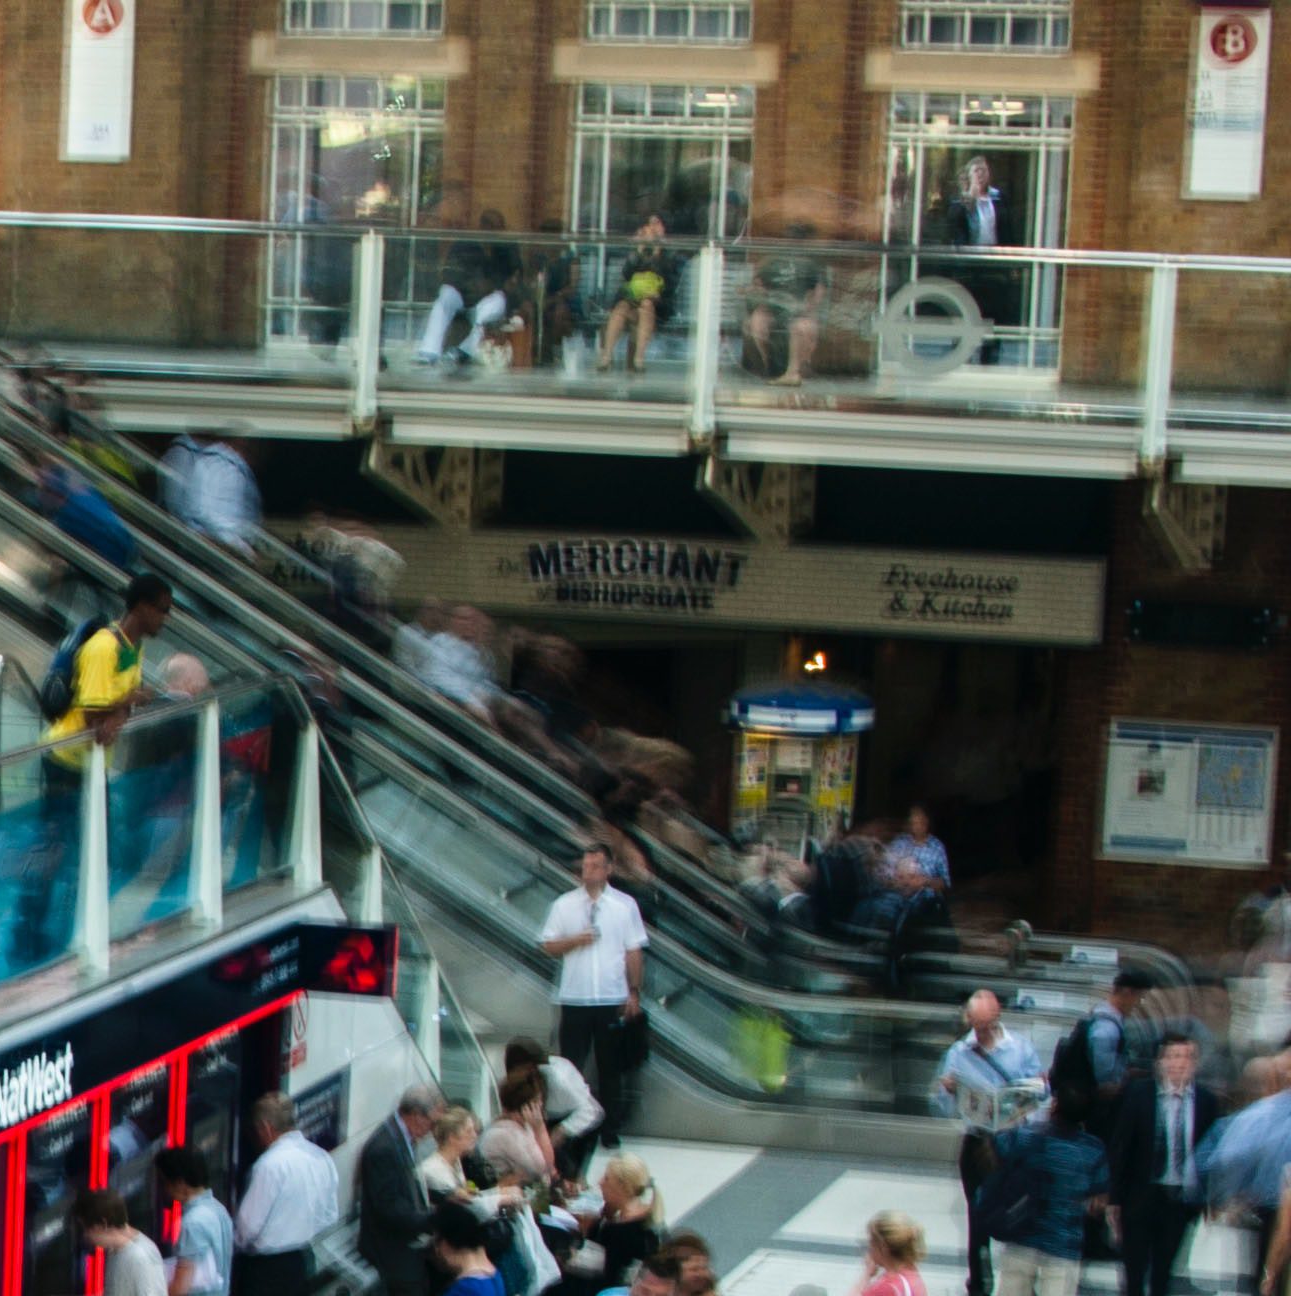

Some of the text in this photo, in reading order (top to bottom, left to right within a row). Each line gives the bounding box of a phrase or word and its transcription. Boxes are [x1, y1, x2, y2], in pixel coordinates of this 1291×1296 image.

[90, 0, 117, 28] A
[1224, 24, 1248, 57] B
[528, 538, 747, 587] MERCHANT
[556, 580, 716, 611] BISHOPSGATE
